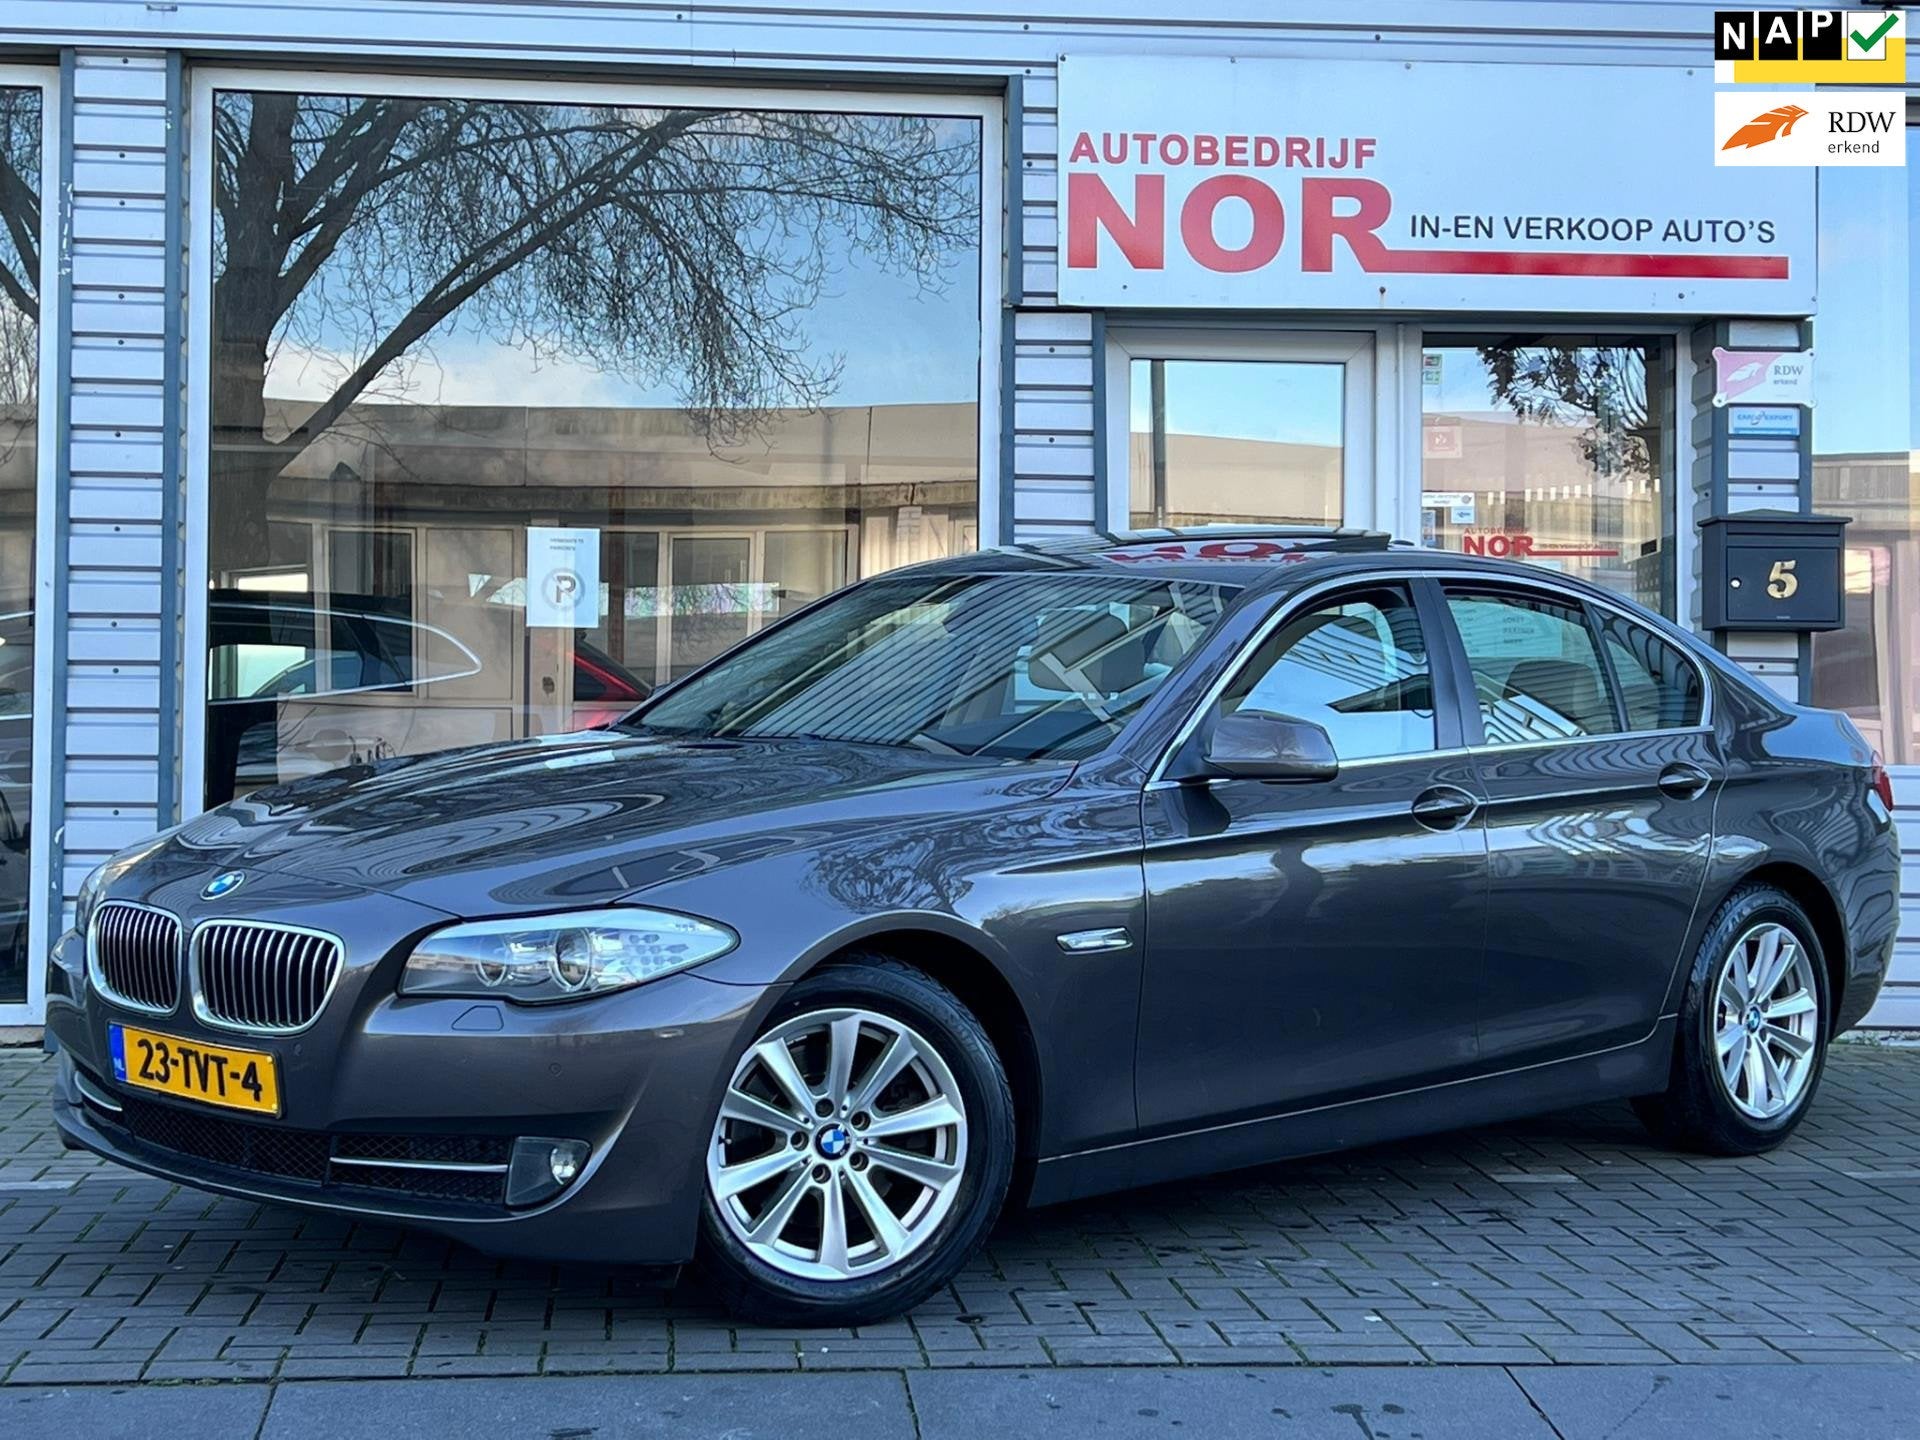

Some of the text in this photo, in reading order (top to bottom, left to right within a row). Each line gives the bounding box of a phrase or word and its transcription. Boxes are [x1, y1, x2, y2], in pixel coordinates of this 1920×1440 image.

[1068, 131, 1377, 169] AUTOBEDRIJF
[1066, 172, 1394, 274] NOR
[1409, 214, 1777, 244] IN-EN VERKOOP AUTO'S
[1774, 365, 1804, 376] RDW
[1463, 535, 1534, 557] NOR
[1766, 559, 1799, 600] 5
[138, 1039, 262, 1102] 23-TVT-4
